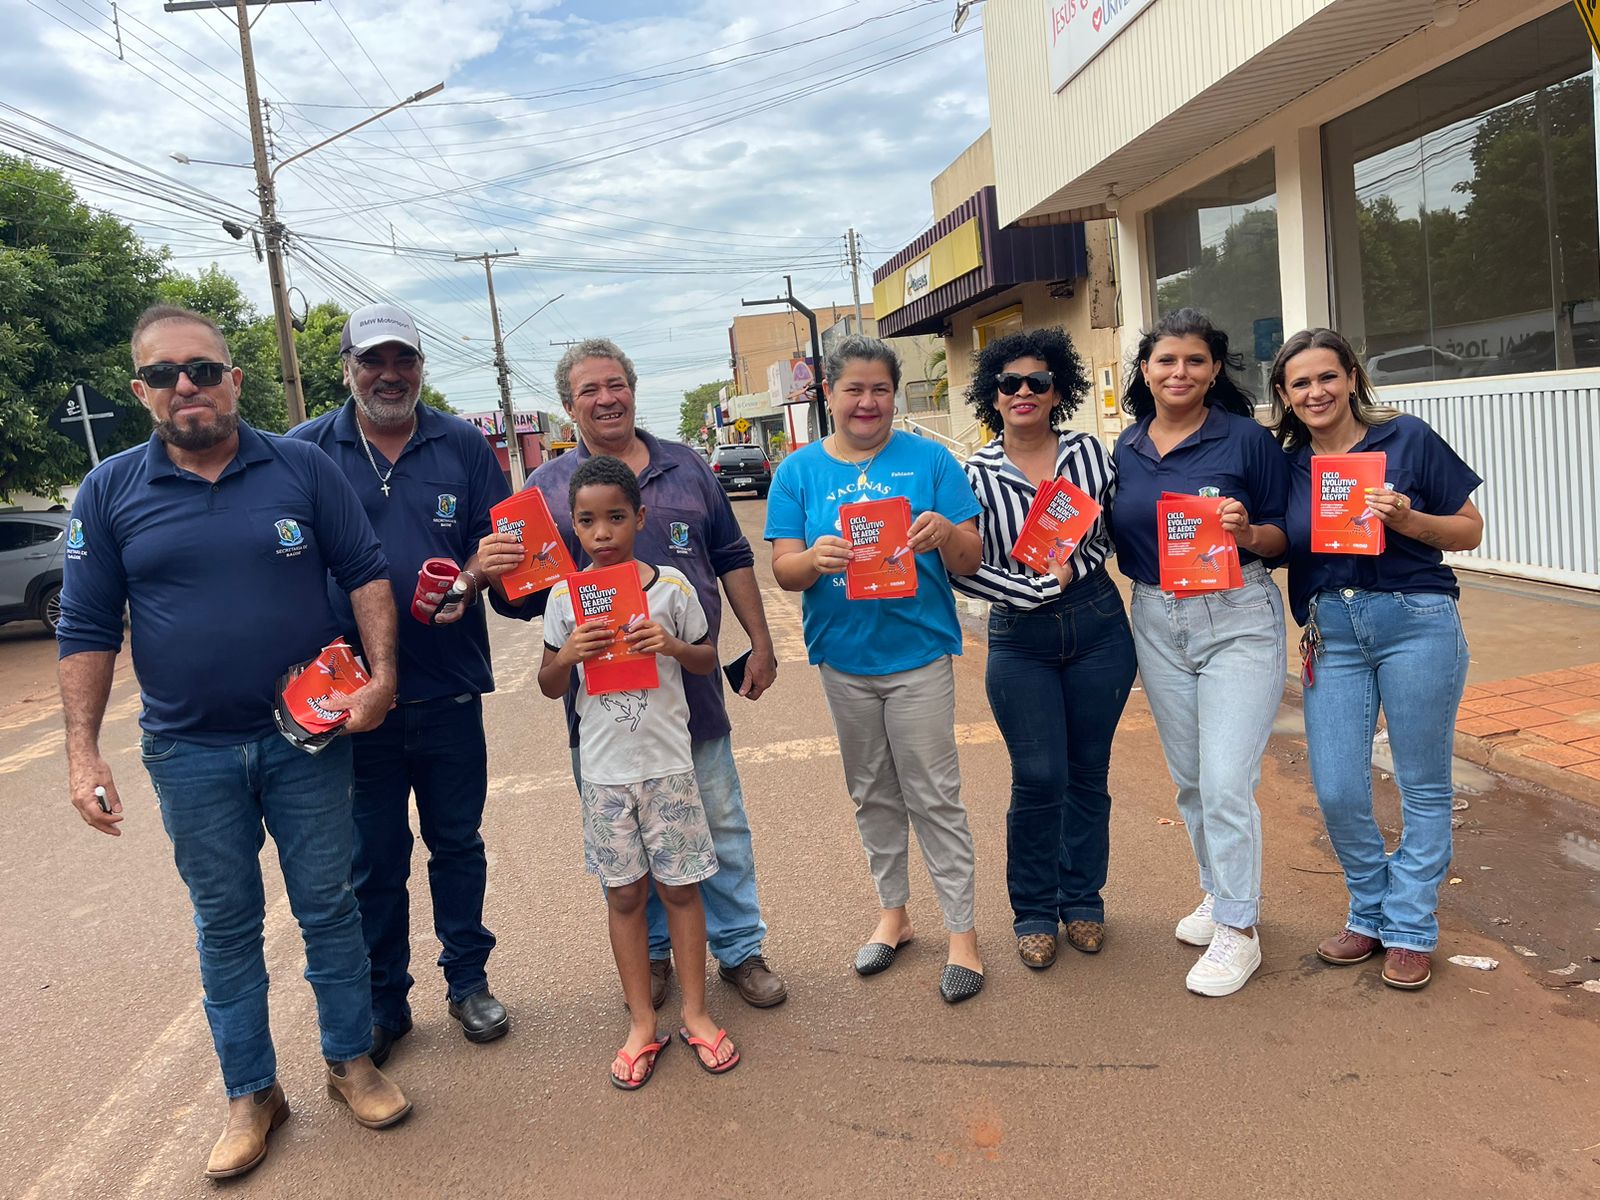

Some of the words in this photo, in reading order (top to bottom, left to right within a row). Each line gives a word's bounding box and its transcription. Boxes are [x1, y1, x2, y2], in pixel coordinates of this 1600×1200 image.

[1052, 0, 1077, 48] JESUS
[826, 481, 892, 500] VACINAS
[1321, 493, 1349, 501] AEGYPTI
[1053, 495, 1080, 517] EVOLUTIVO
[850, 516, 867, 525] CICLO
[1167, 512, 1184, 520] CICLO
[850, 520, 885, 532] EVOLUTIVO
[1167, 518, 1202, 527] EVOLUTIVO
[852, 531, 861, 539] DE
[861, 528, 880, 538] AEDES
[1168, 532, 1195, 540] AEGYPTI
[853, 536, 879, 546] AEGYPTI
[579, 584, 598, 594] CICLO
[580, 588, 617, 601] EVOLUTIVO
[582, 601, 592, 609] DE
[592, 597, 613, 607] AEDES
[584, 605, 613, 616] AEGYPTI
